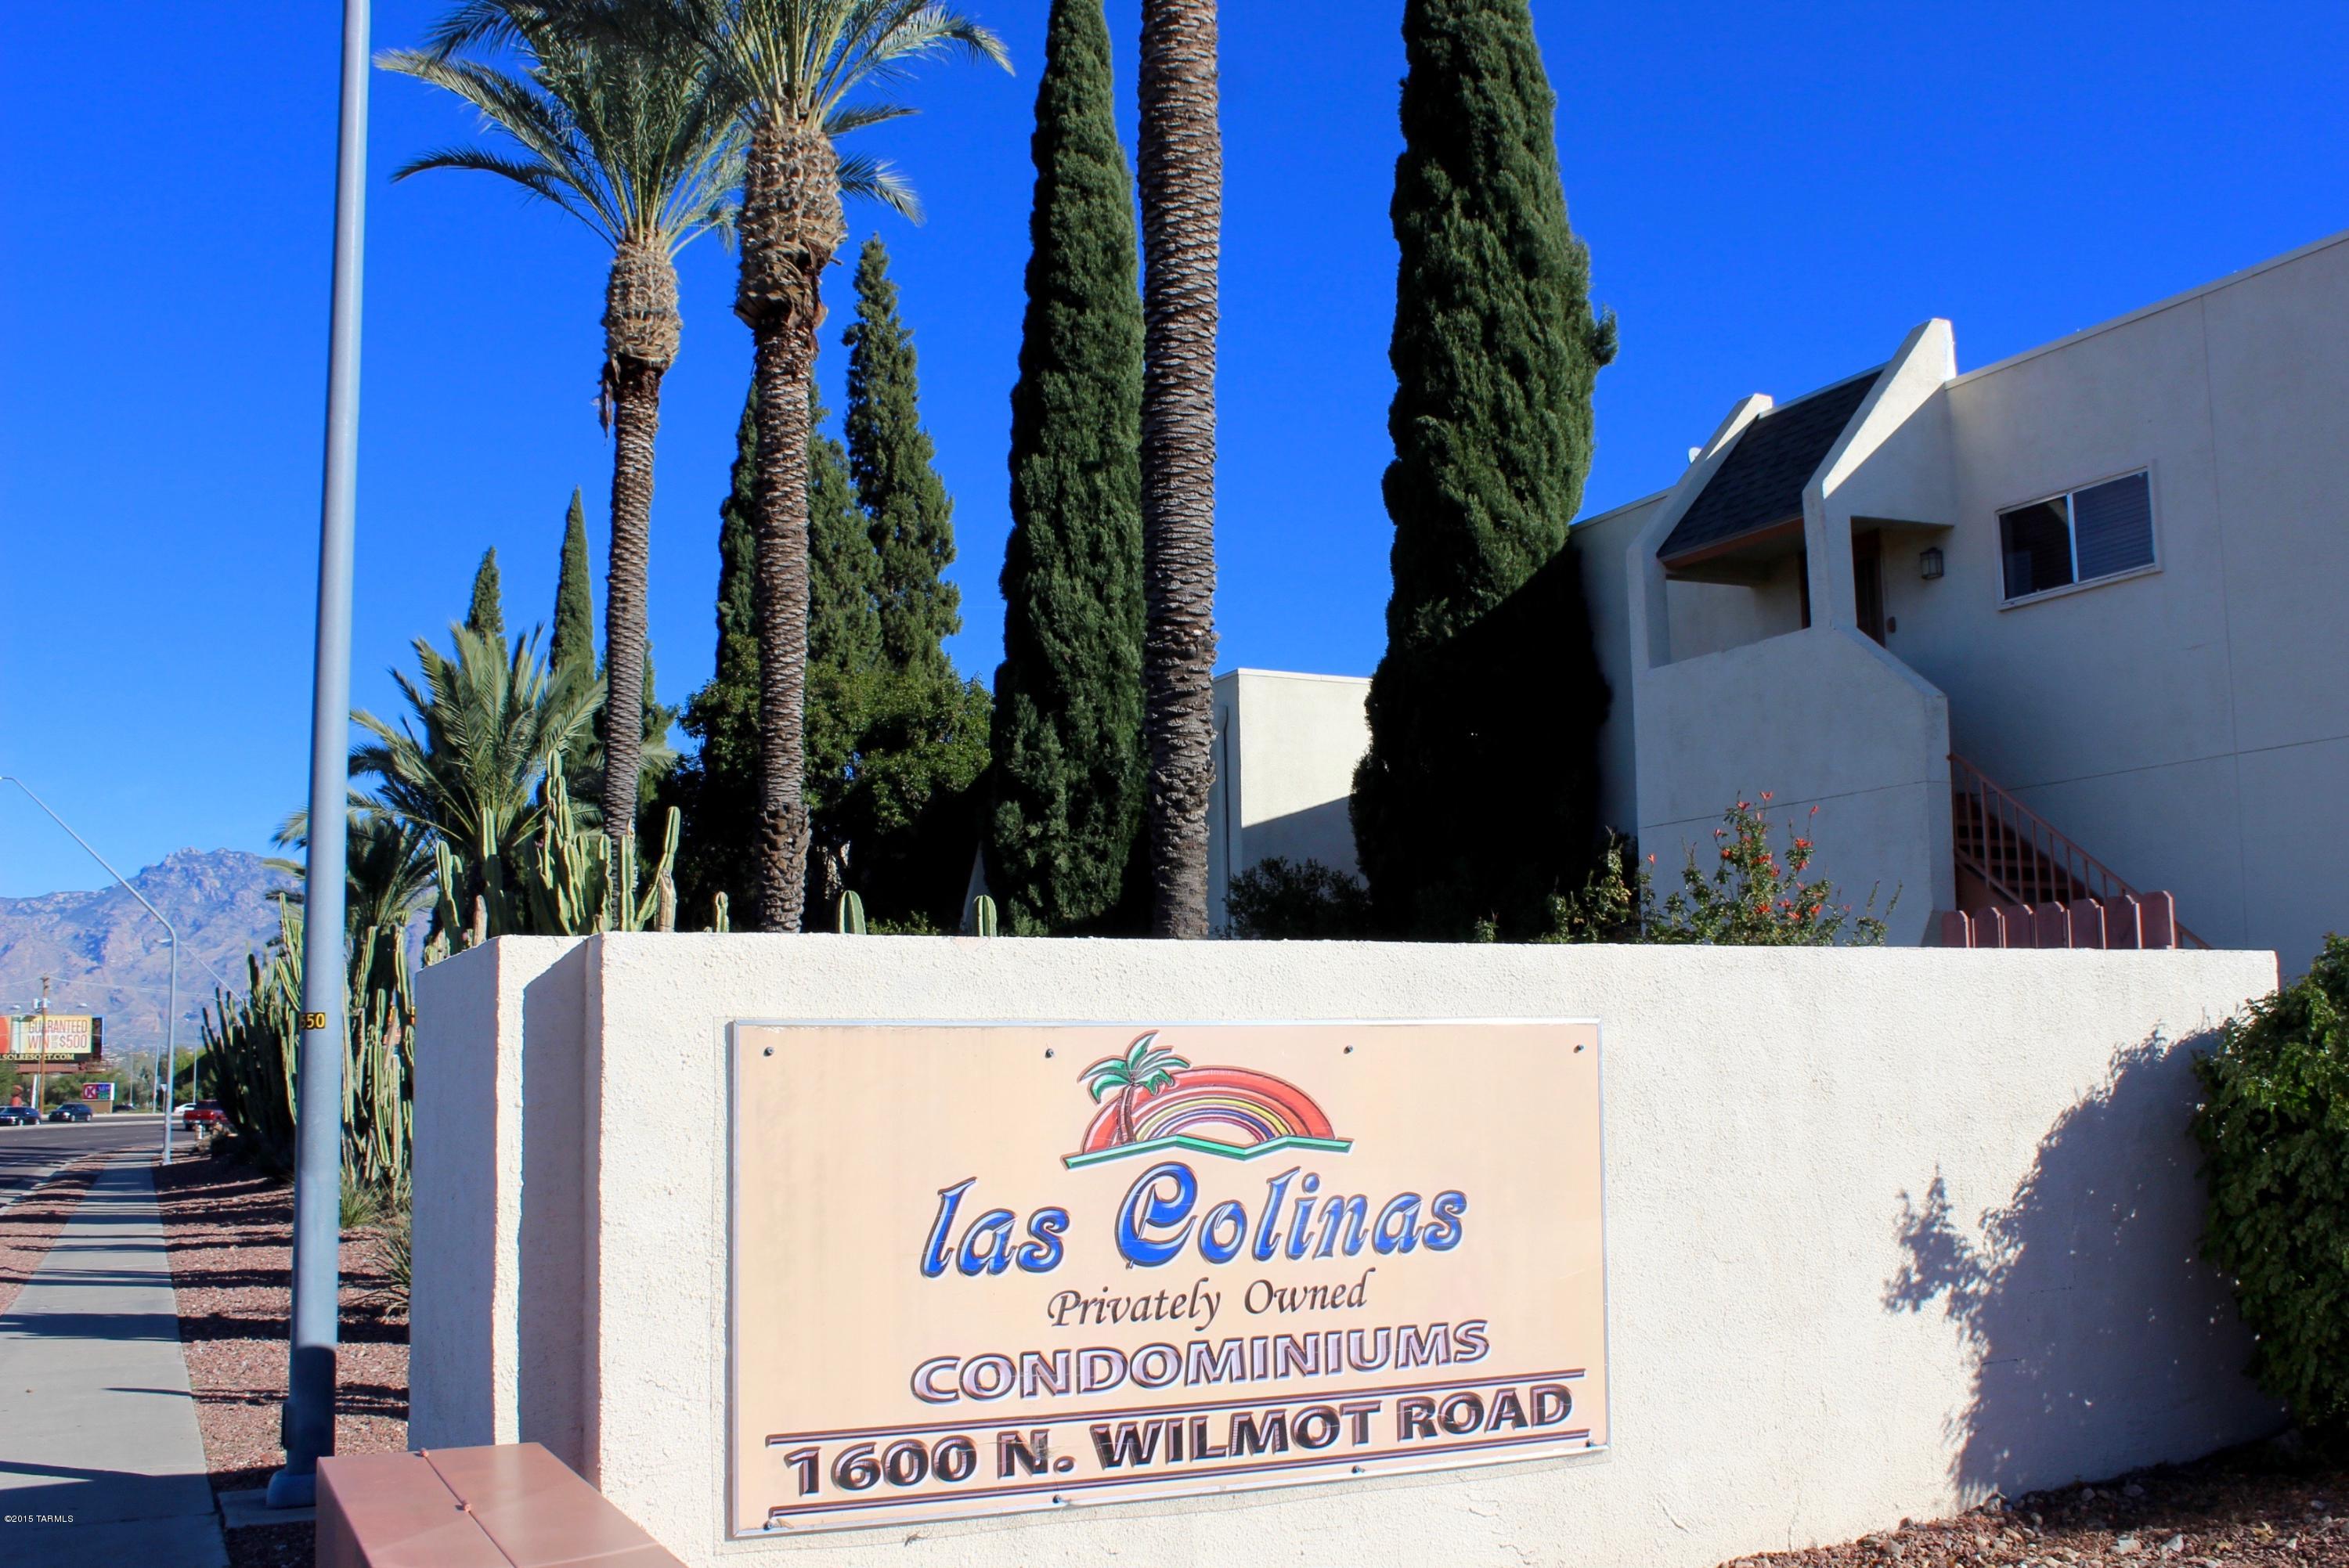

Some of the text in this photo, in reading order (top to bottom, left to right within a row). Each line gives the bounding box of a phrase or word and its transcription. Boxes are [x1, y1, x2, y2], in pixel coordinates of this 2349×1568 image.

[28, 1034, 49, 1049] WIN
[59, 1033, 88, 1049] $500
[1114, 1162, 1469, 1270] Colinas
[1047, 1267, 1376, 1331] Privately Owned
[911, 1319, 1490, 1404] CONDOMINIUMS
[784, 1382, 1574, 1497] 1600 N. WILMOT ROAD
